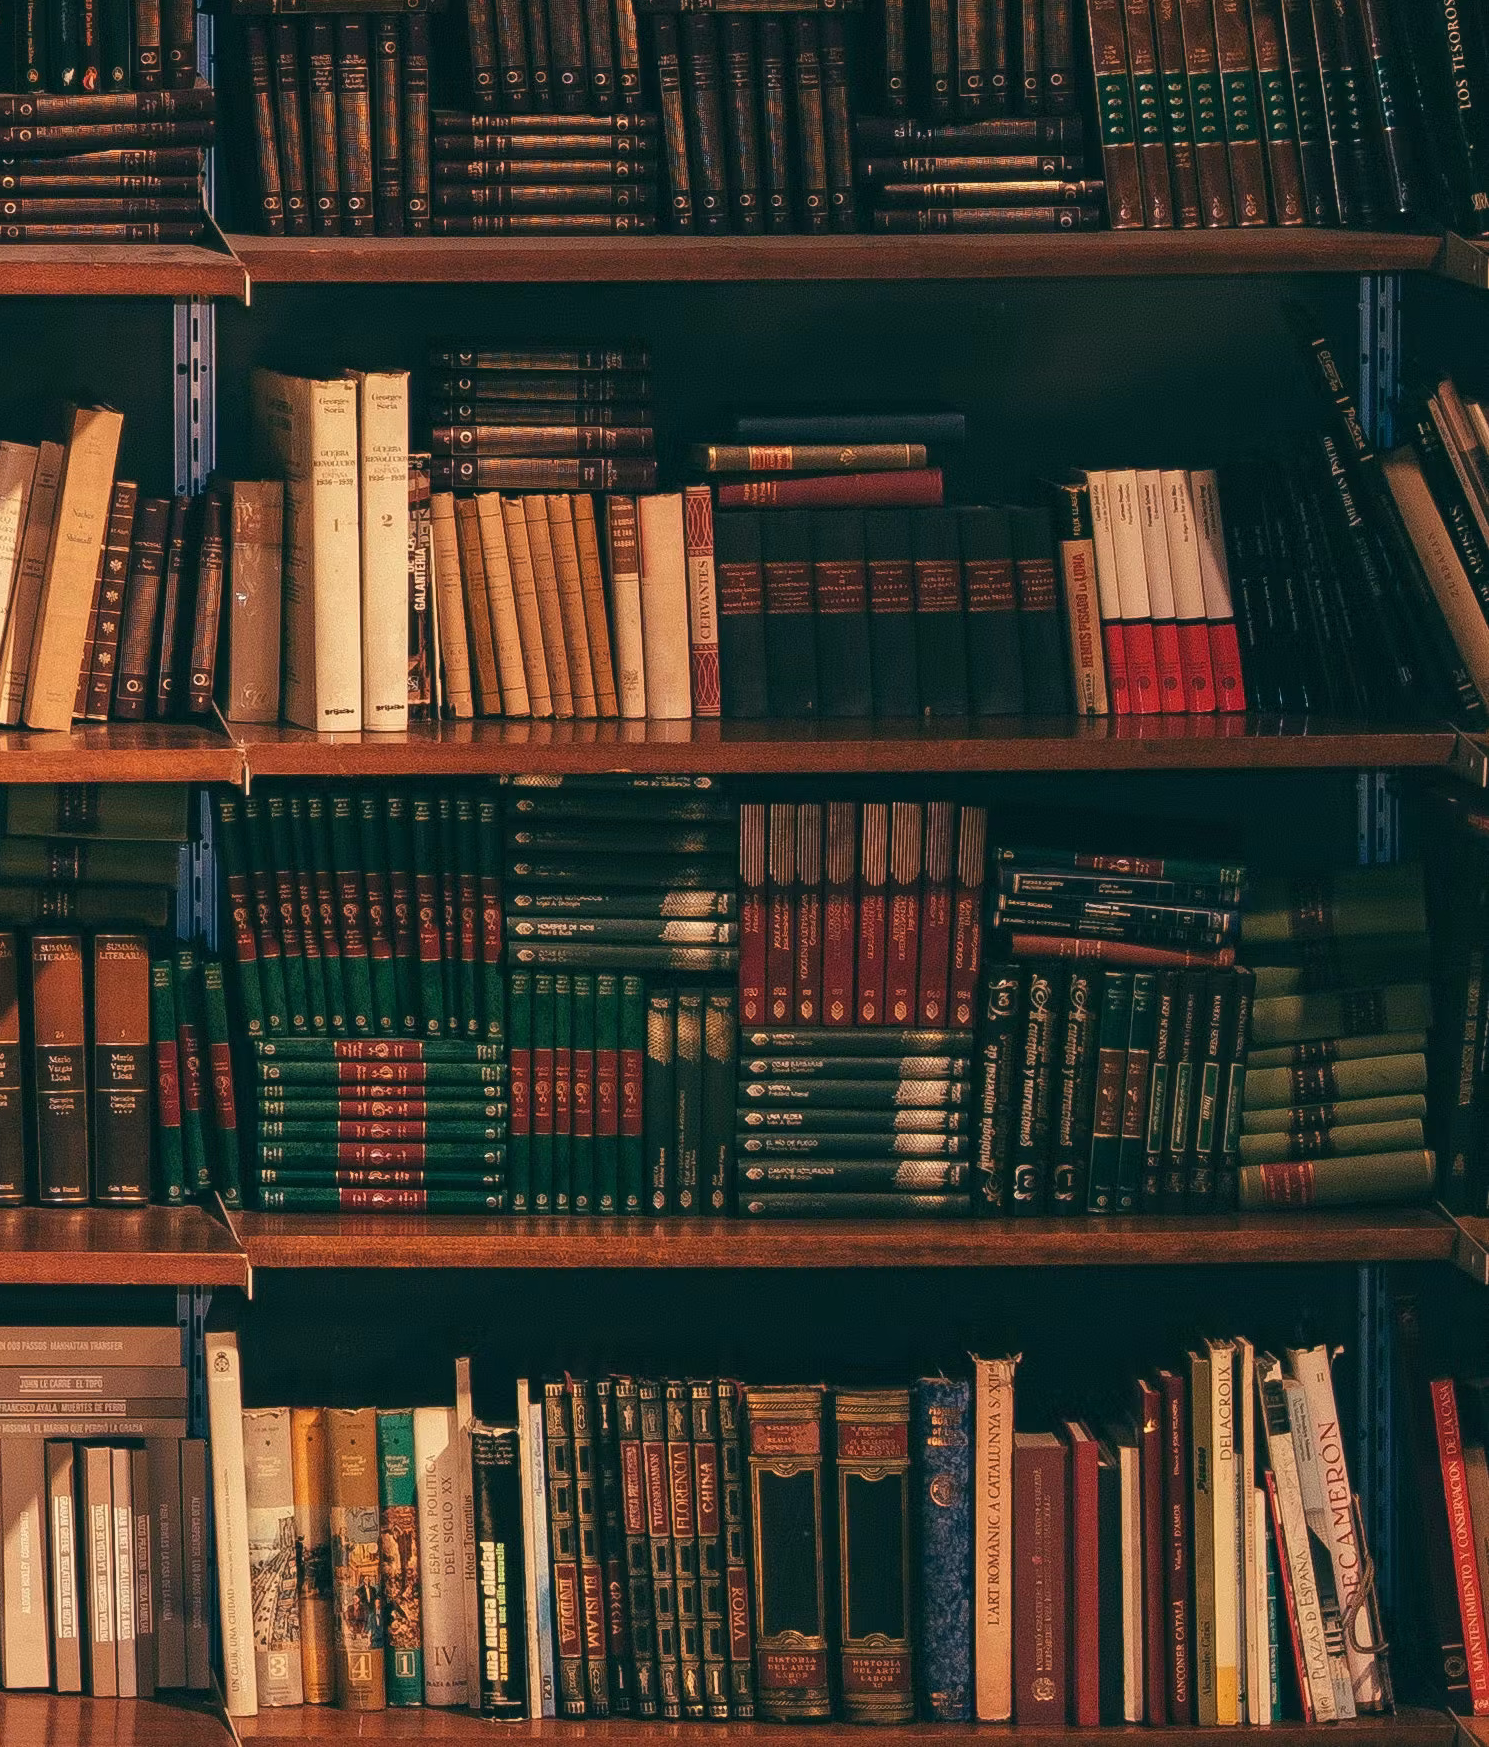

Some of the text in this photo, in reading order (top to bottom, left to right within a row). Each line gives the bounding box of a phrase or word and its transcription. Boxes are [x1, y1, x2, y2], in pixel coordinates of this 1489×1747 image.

[1444, 0, 1469, 73] TESOROS
[1455, 78, 1473, 109] LOS
[699, 560, 711, 640] CERVANTES
[1218, 1367, 1231, 1461] DELACROIX
[674, 1451, 689, 1529] FLORENCIA
[700, 1463, 713, 1512] CHINA
[987, 1411, 1001, 1499] CATALUNYA
[987, 1499, 1000, 1511] A
[732, 1591, 746, 1641] ROMA
